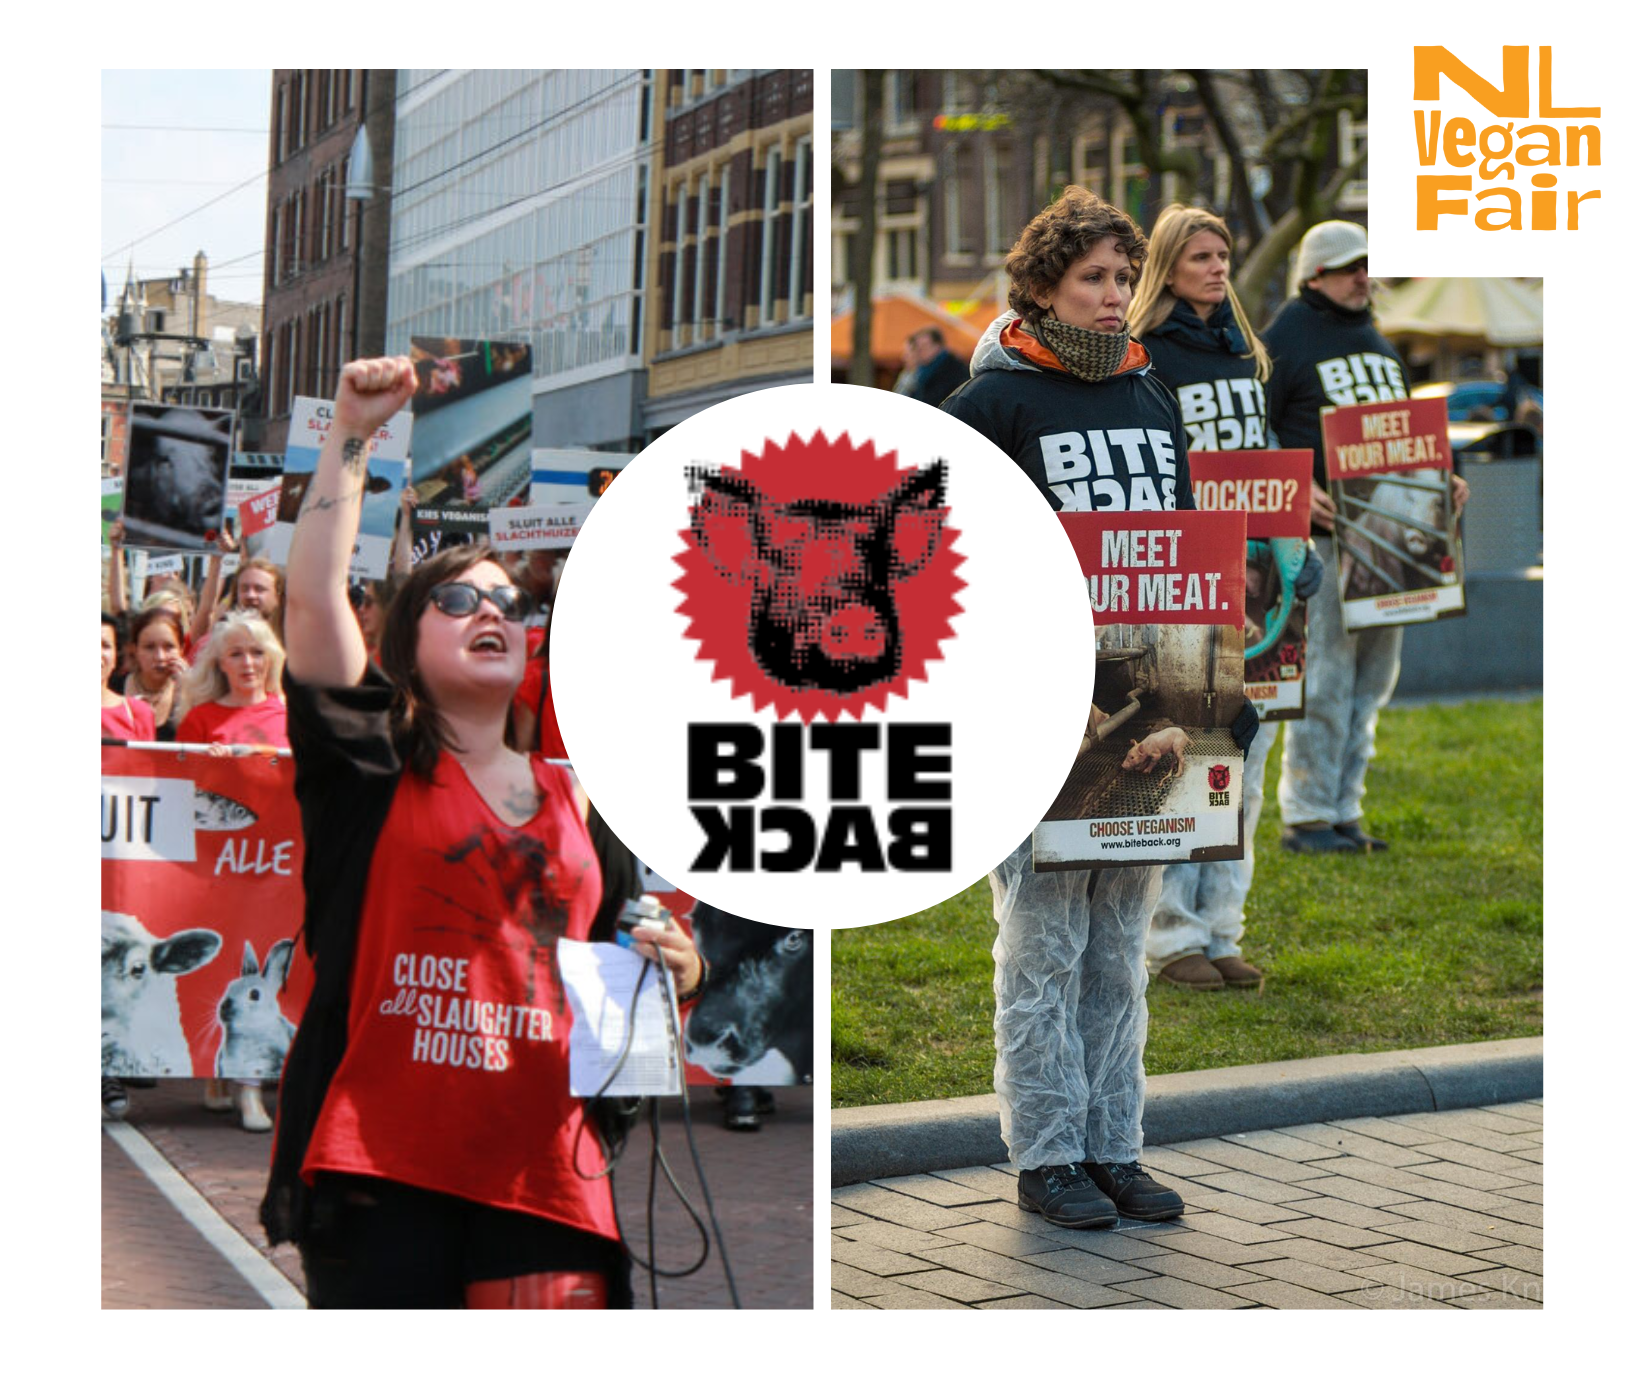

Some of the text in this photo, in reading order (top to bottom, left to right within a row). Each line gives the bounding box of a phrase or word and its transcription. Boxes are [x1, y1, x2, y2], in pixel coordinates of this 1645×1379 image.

[1316, 352, 1405, 393] BITE
[1361, 409, 1411, 441] MEET
[1039, 428, 1176, 483] BITE
[1335, 433, 1443, 472] YOUR MEAT.
[441, 510, 490, 522] VEGANIS
[508, 516, 576, 529] SLUIT ALLE
[1101, 530, 1182, 568] MEET
[1084, 572, 1229, 612] UR MEAT.
[1208, 791, 1230, 800] BITE
[1089, 817, 1196, 838] CHOOSE VEGANISM
[1101, 837, 1181, 850] www.biteback.org
[213, 838, 294, 876] ALLE
[394, 953, 469, 992] CLOSE
[380, 989, 554, 1042] all SLAUGHTER
[413, 1028, 509, 1072] HOUSES
